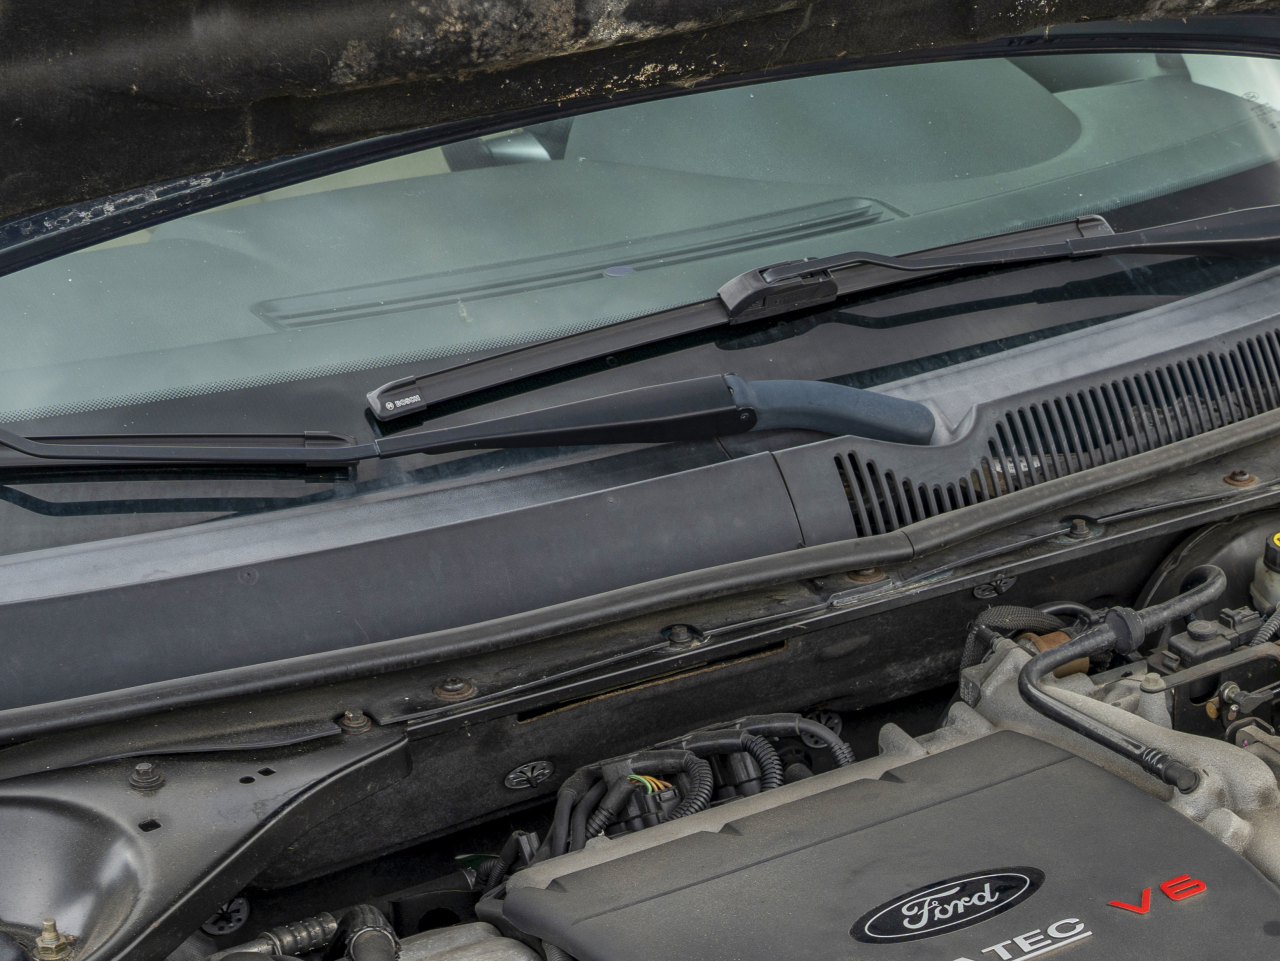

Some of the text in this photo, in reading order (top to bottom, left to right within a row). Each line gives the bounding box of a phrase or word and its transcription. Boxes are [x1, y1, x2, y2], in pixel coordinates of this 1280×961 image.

[395, 395, 421, 407] BOSCH
[901, 882, 999, 930] Ford
[1106, 874, 1206, 915] V6
